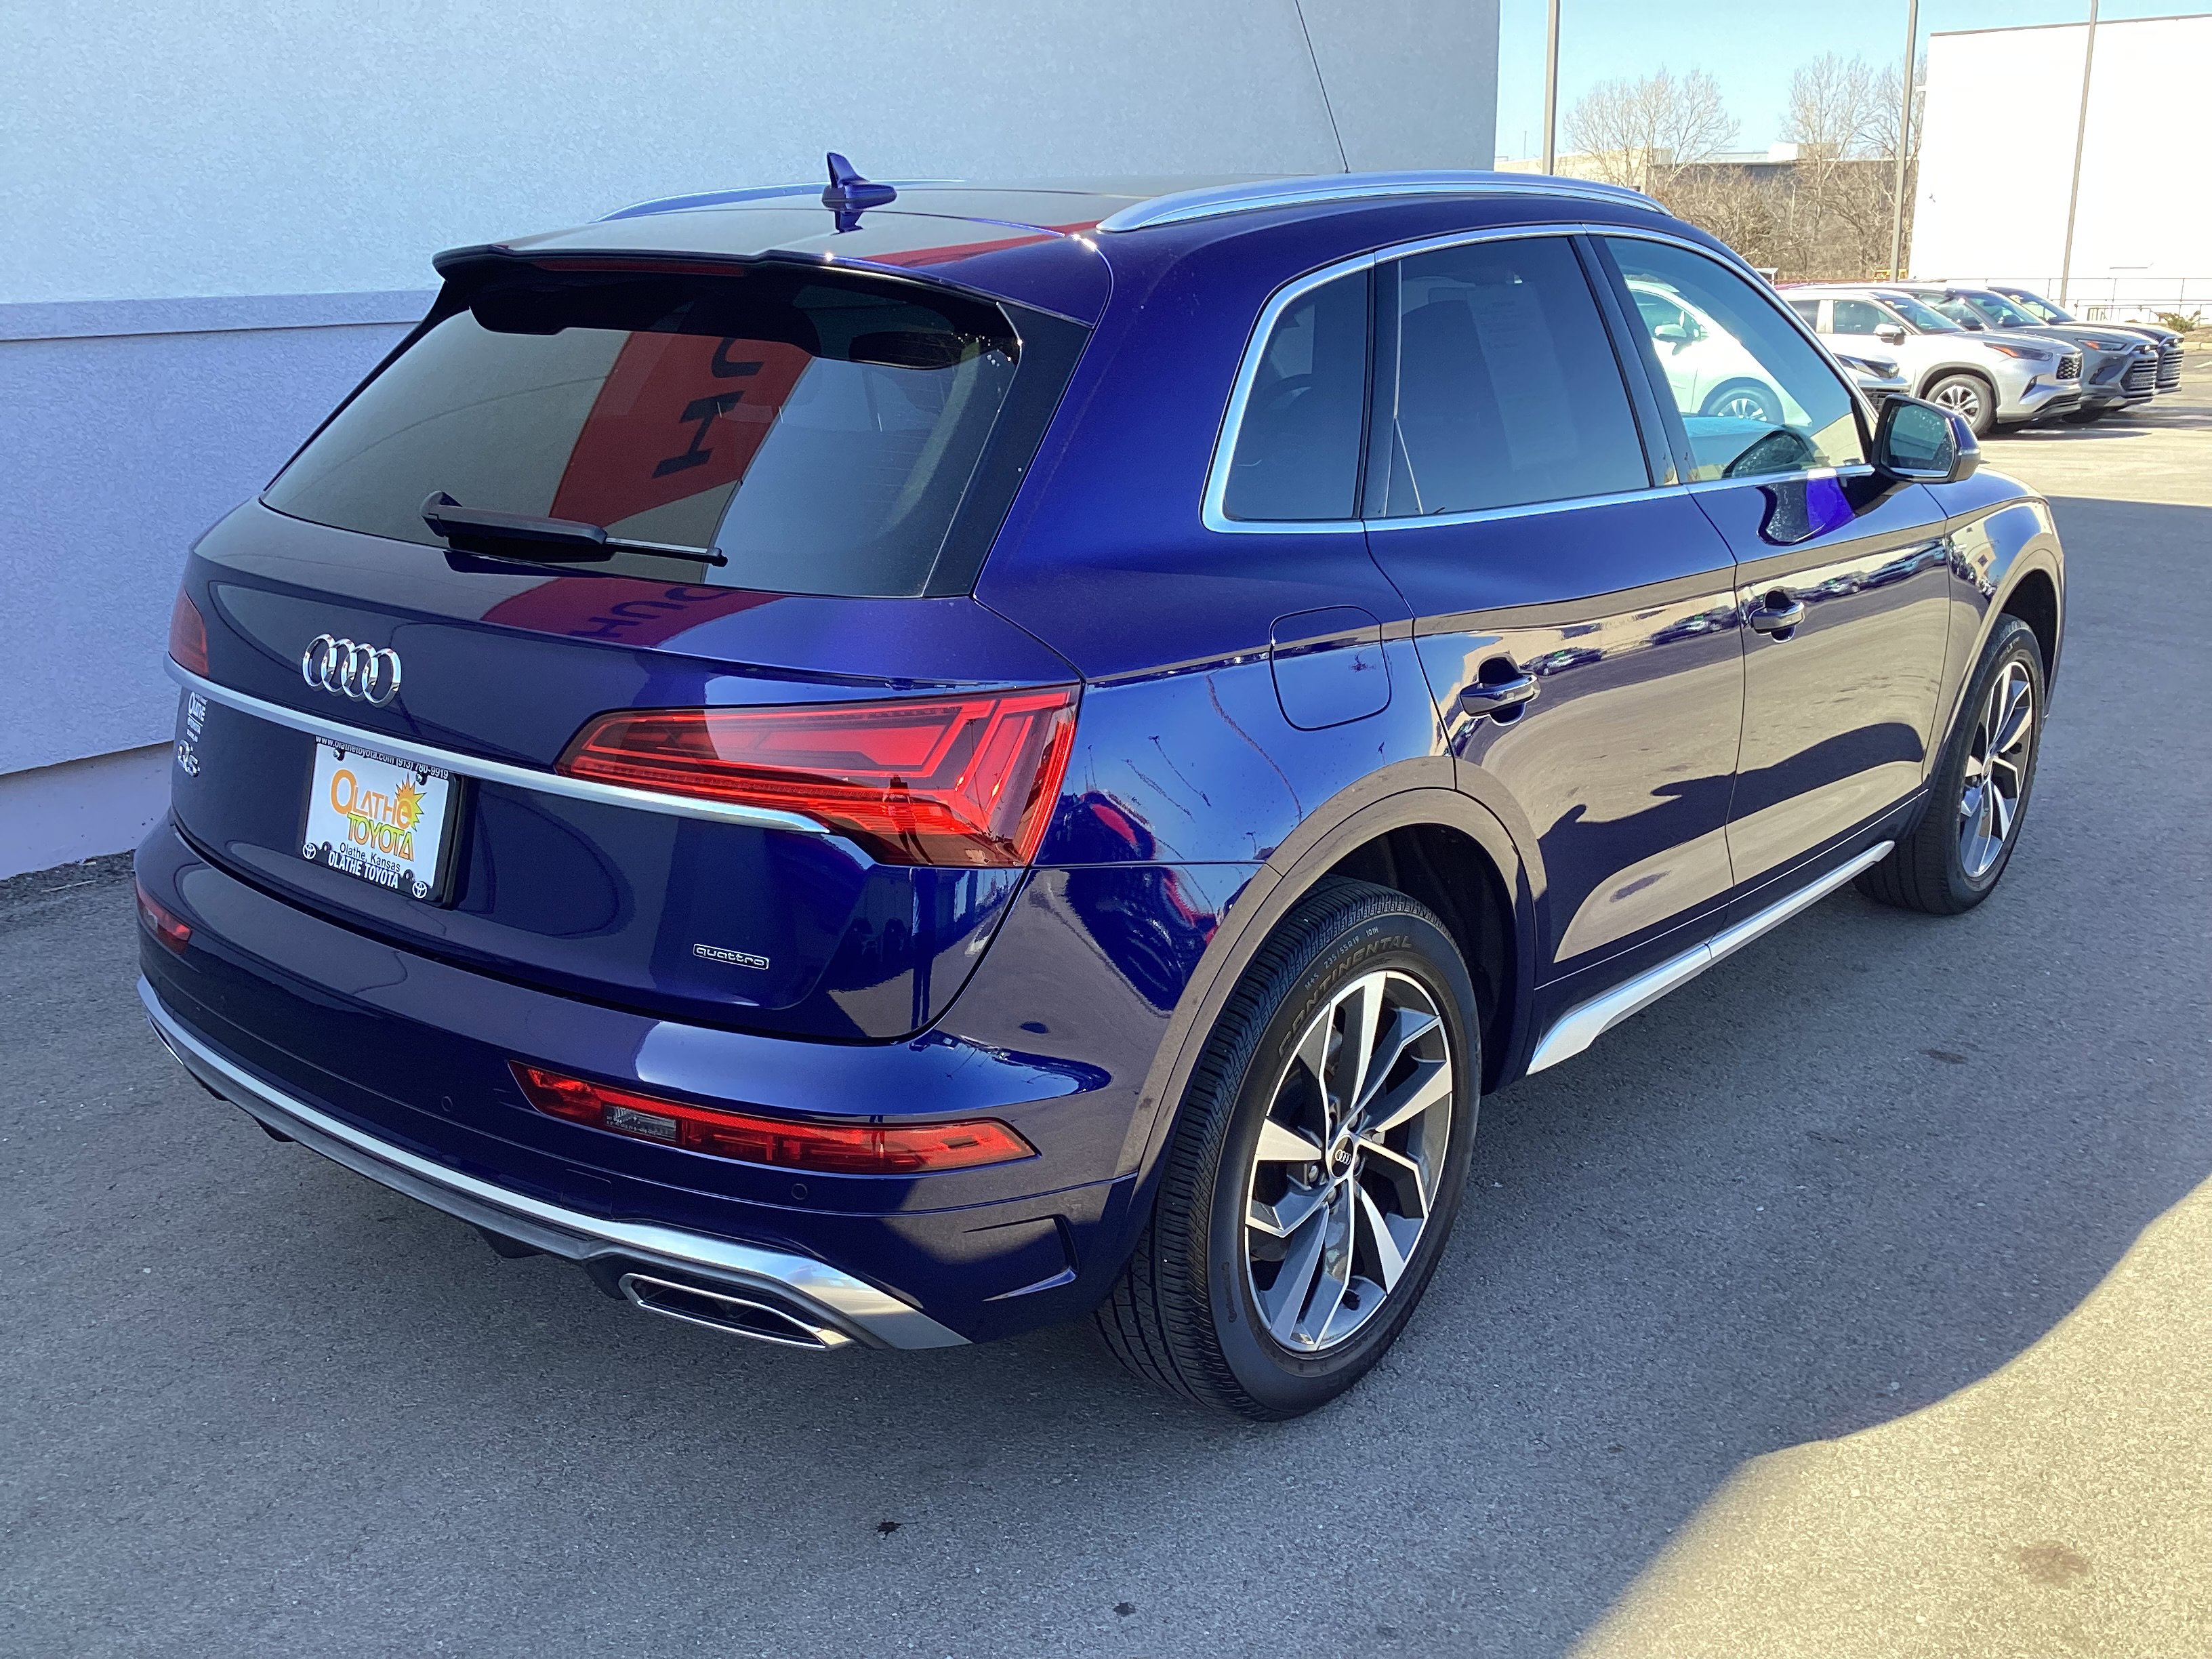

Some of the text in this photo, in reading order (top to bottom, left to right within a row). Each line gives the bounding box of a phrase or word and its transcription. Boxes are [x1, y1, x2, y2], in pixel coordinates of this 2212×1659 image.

[415, 761, 449, 780] 780-9919
[347, 813, 415, 862] TOYOTA
[340, 842, 401, 872] Olathe, Kansas
[328, 851, 398, 889] OLATHE TOYOTA
[1366, 926, 1379, 937] 101H
[696, 947, 764, 966] quattro
